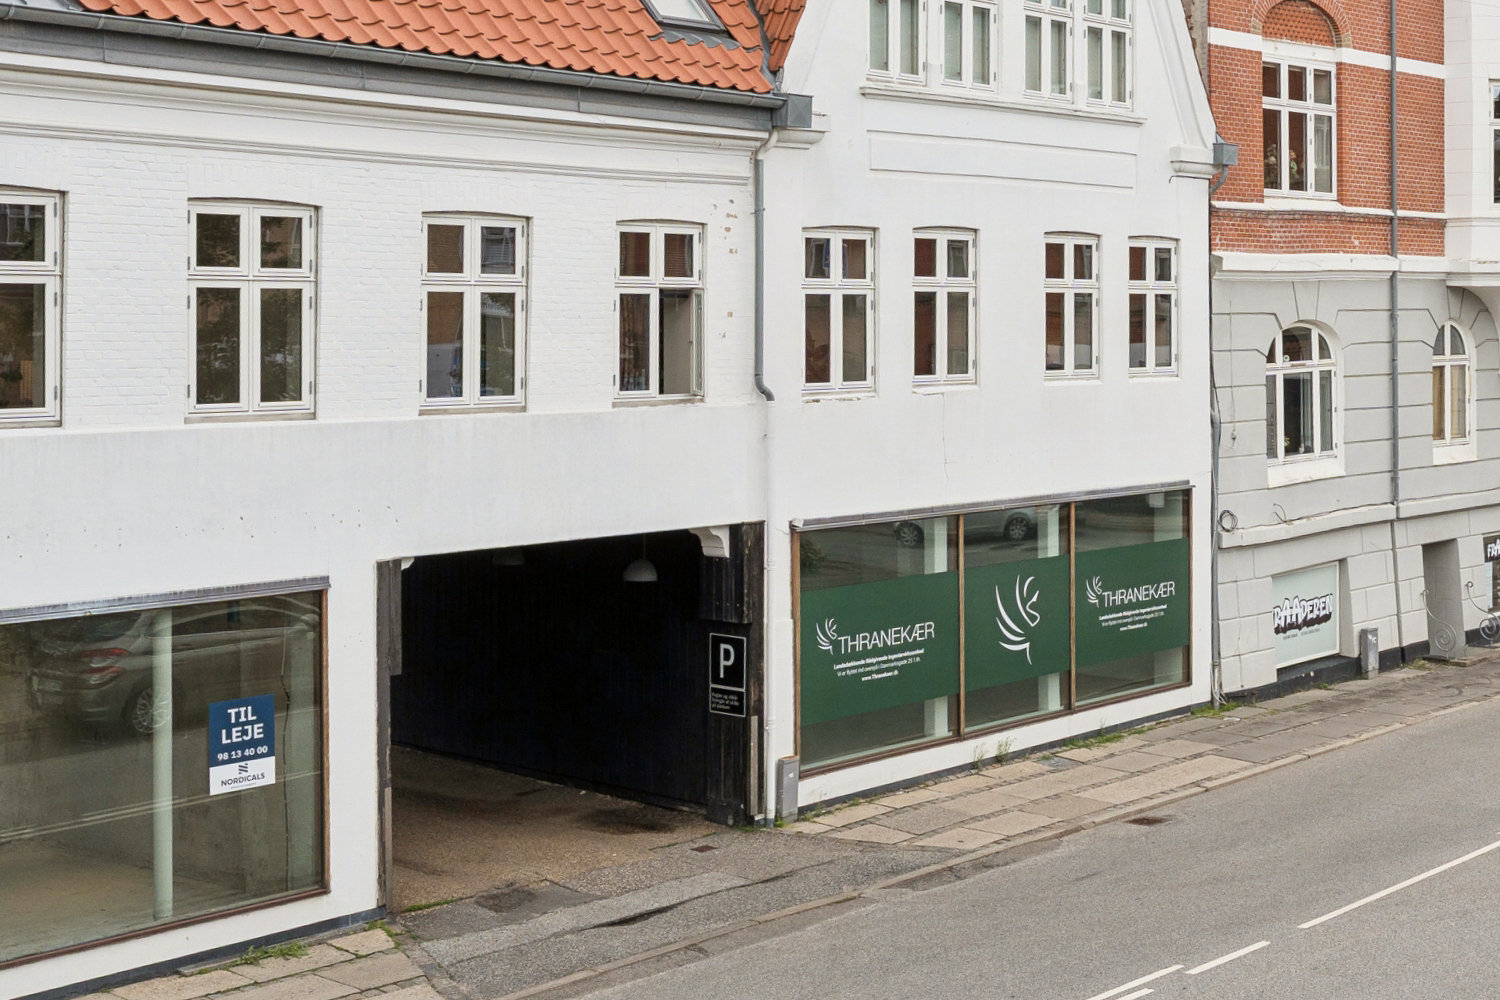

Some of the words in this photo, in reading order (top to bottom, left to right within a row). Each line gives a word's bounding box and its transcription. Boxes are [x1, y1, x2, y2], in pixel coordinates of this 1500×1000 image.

[1102, 580, 1176, 608] THRANEKÆR
[1273, 593, 1333, 633] RAADEREN
[837, 621, 935, 655] THRANEKÆR
[719, 642, 735, 679] P
[227, 705, 257, 723] TIL
[221, 722, 264, 745] LEJE
[217, 752, 229, 761] 98
[230, 749, 242, 759] 13
[243, 747, 255, 756] 40
[256, 745, 268, 755] 00
[221, 772, 265, 787] NORDICALS
